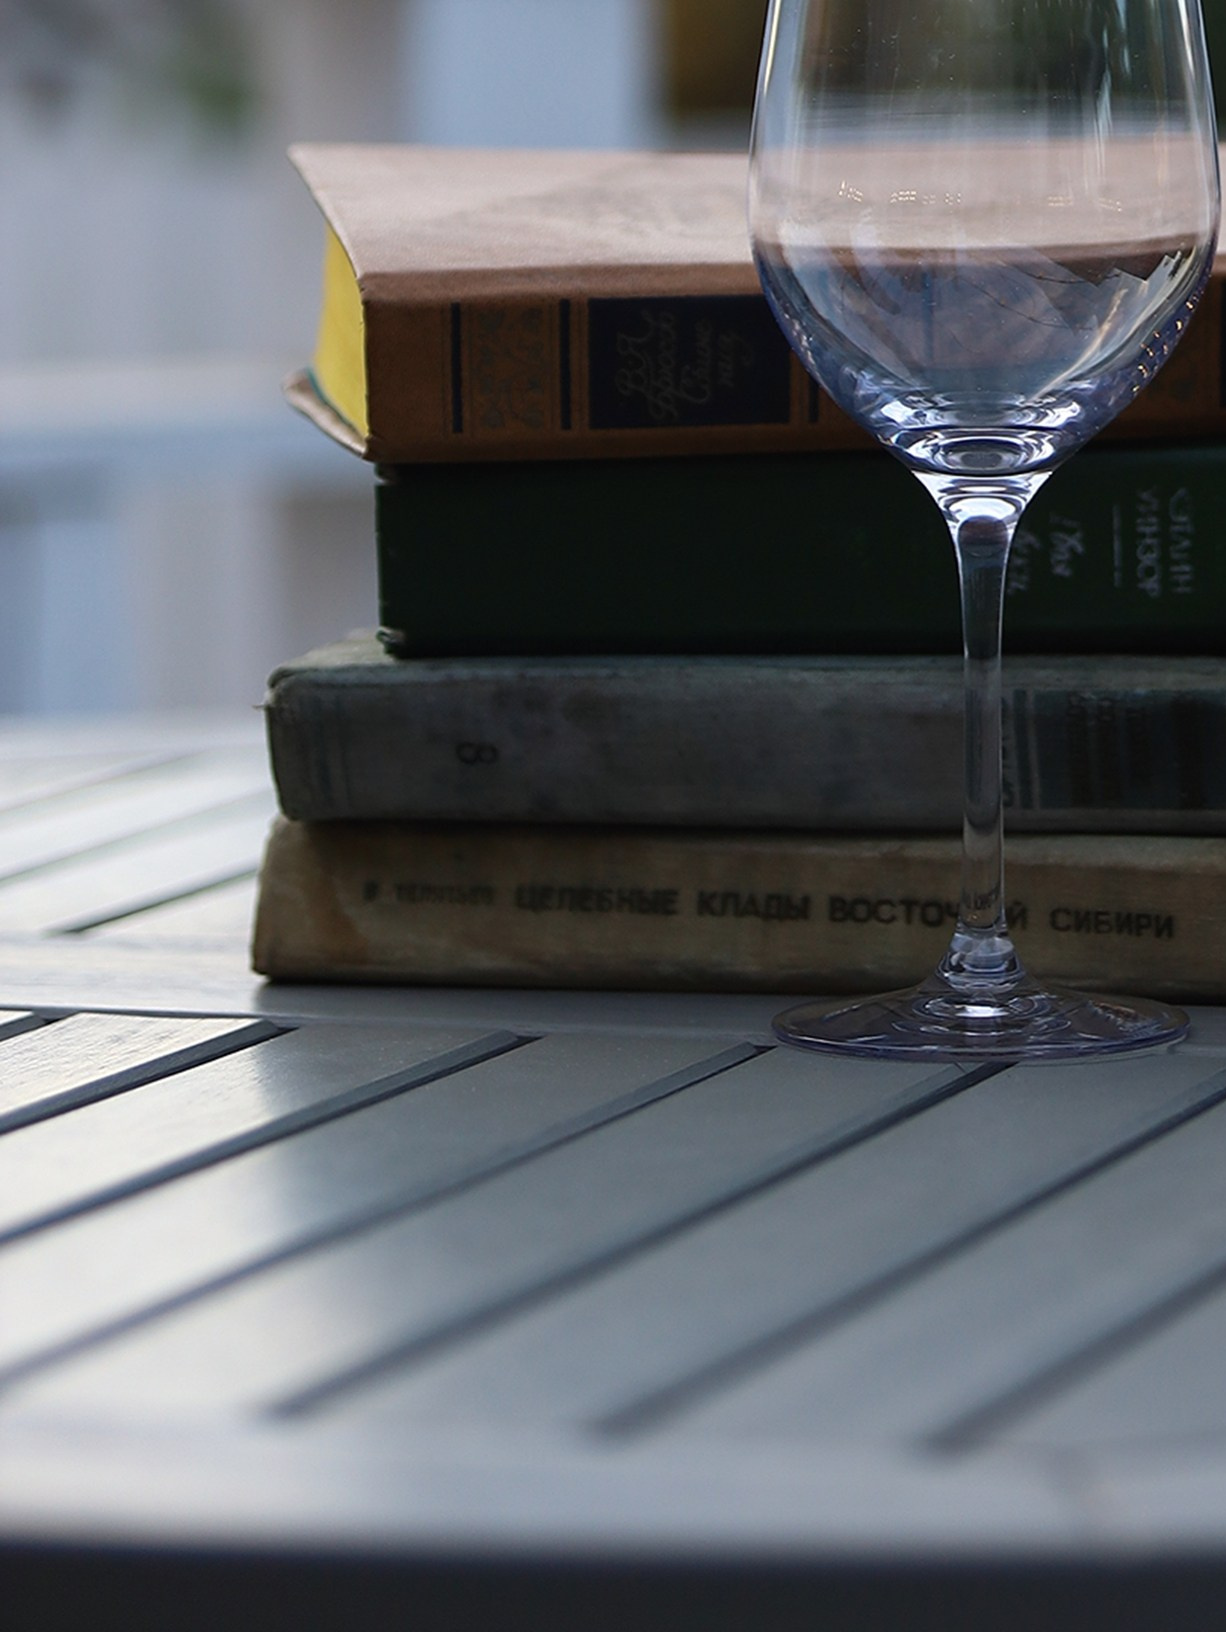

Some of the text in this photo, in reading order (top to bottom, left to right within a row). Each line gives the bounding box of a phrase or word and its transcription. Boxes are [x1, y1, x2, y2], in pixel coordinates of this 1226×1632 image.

[514, 882, 679, 915] ЦЕЛЕБНЫЕ
[697, 888, 810, 921] КЛАДЫ
[828, 894, 1028, 930] ВОСТОЧЙ
[1050, 906, 1176, 939] СИБИРИ
